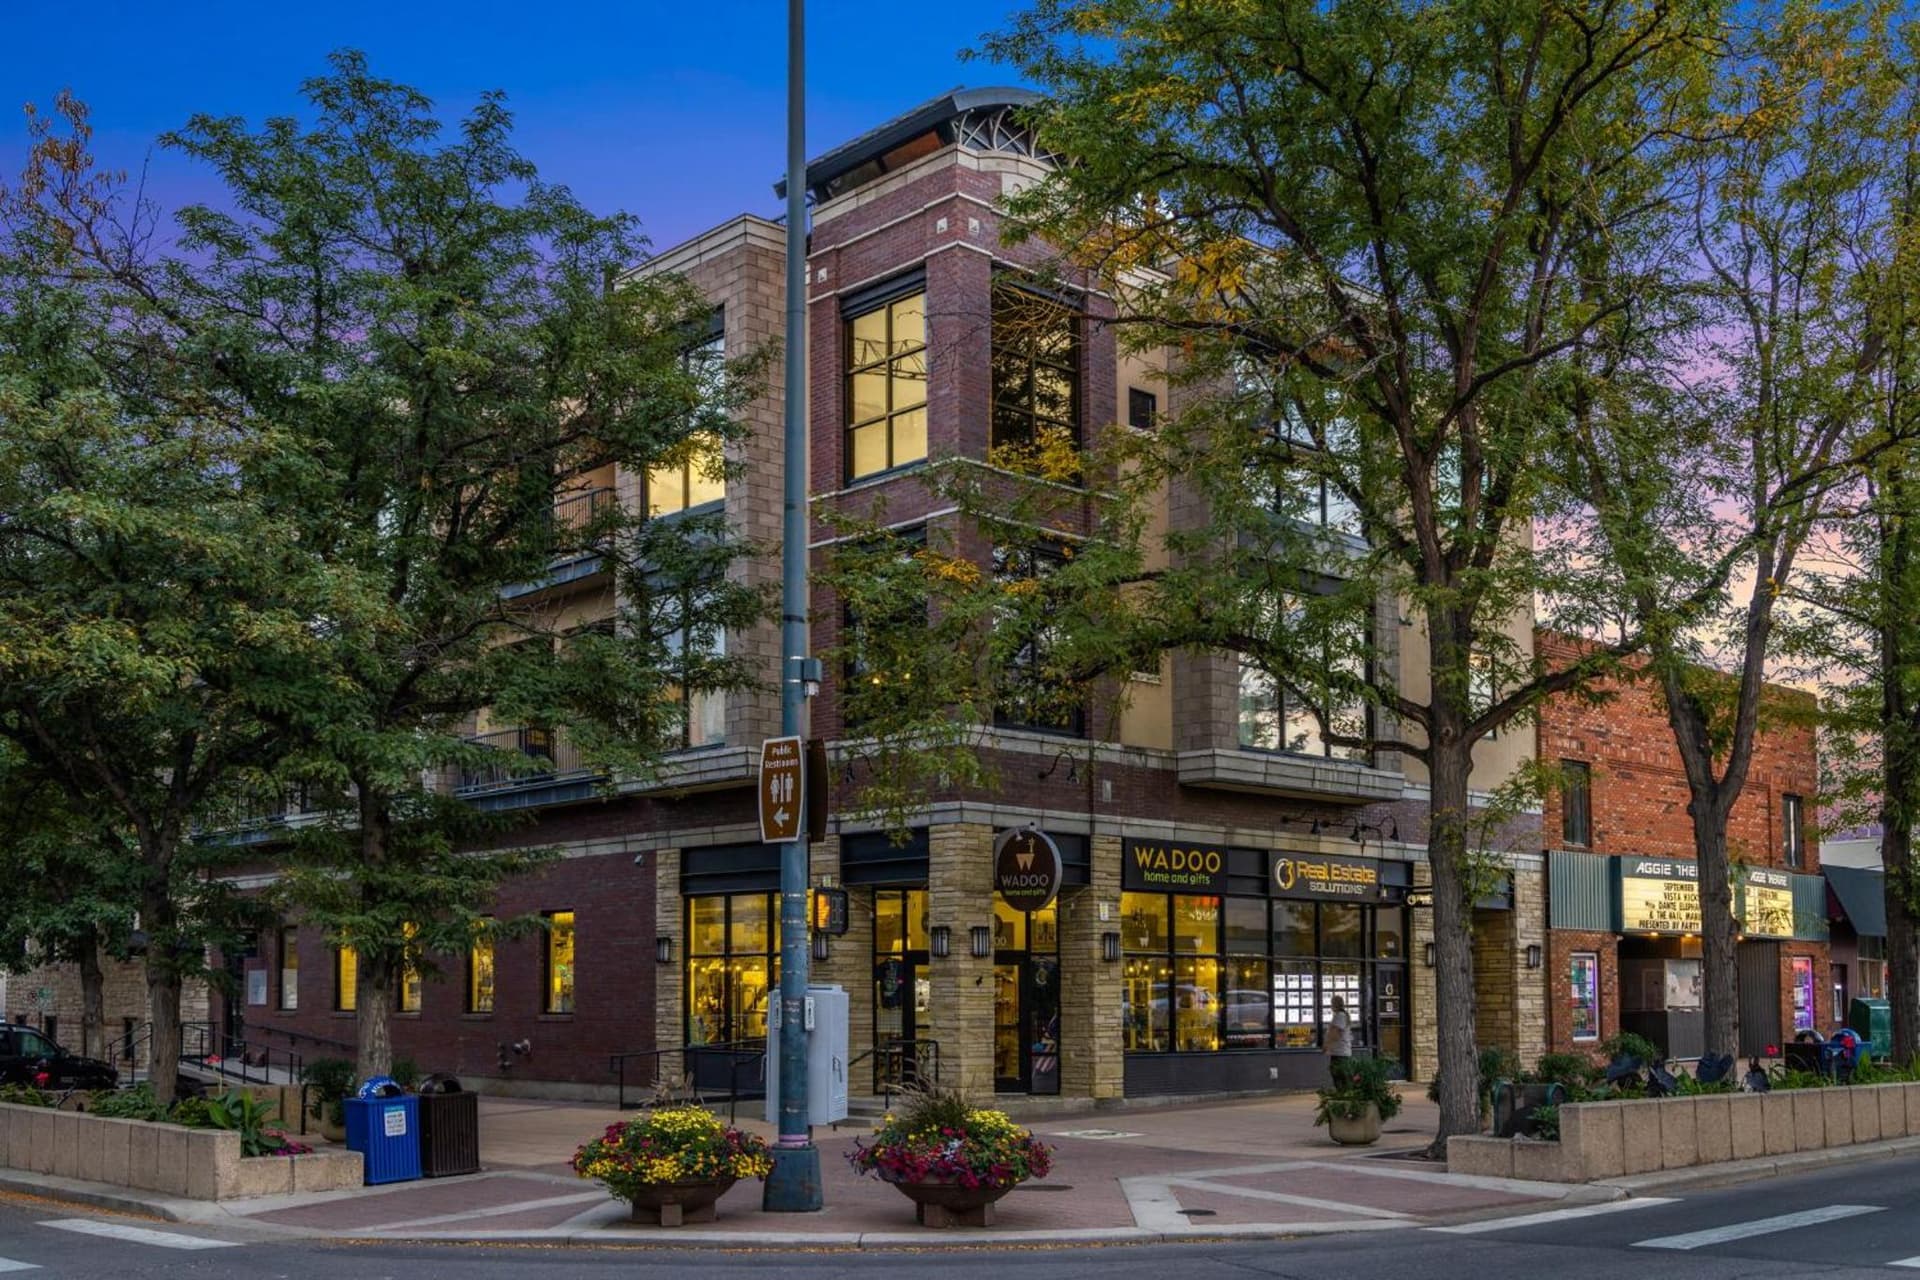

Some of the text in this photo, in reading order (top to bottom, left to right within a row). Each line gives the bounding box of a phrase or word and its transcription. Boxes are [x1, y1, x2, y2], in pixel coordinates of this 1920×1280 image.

[1134, 846, 1221, 873] WADOO
[1296, 860, 1377, 884] Real Estate
[1636, 862, 1699, 877] AGGIE THE
[1001, 873, 1049, 888] WADOO
[1144, 870, 1211, 887] home and gifts
[1309, 881, 1363, 895] SOLUTIONS
[1663, 882, 1695, 892] SEPTEMBER
[1663, 892, 1681, 902] VISTA
[1656, 910, 1666, 920] THE
[1638, 919, 1670, 930] PRESENTED
[1671, 920, 1680, 930] BY
